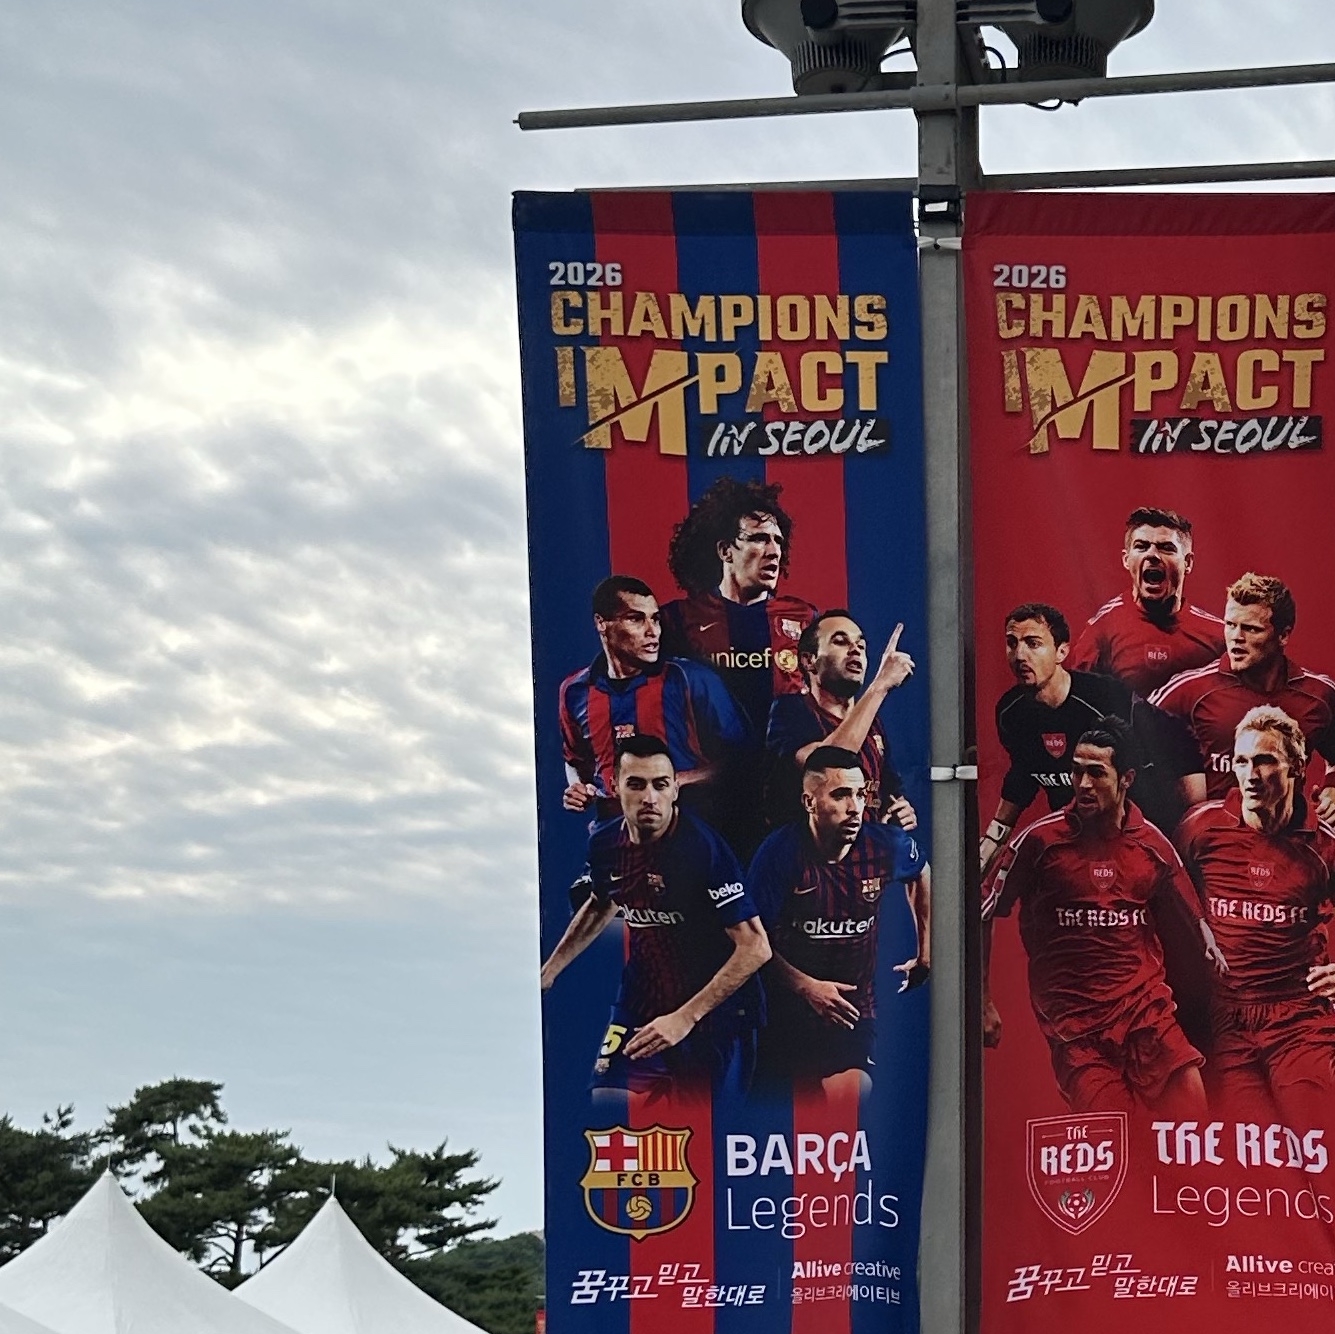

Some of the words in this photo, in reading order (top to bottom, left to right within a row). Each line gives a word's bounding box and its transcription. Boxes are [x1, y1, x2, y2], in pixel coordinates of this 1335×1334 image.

[548, 261, 623, 287] 2026
[993, 264, 1067, 289] 2026
[549, 290, 889, 343] CHAMPIONS
[995, 292, 1327, 342] CHAMPIONS
[554, 345, 890, 457] IMPACT
[1000, 346, 1325, 455] IMPACT
[758, 418, 886, 455] SEOUL
[1191, 416, 1317, 454] SEOUL
[707, 881, 744, 901] beko
[1055, 907, 1084, 927] THE
[1087, 908, 1130, 927] REDS
[1208, 897, 1238, 918] THE
[1241, 900, 1287, 923] REDS
[1289, 906, 1309, 924] FC
[600, 1024, 628, 1056] 5
[726, 1130, 872, 1183] BARÇA
[1041, 1140, 1115, 1176] REDS
[1151, 1121, 1225, 1167] THE
[1235, 1122, 1329, 1174] REDS
[617, 1173, 660, 1187] FCB
[727, 1179, 900, 1240] Legends
[1152, 1174, 1335, 1227] Legends
[657, 1262, 710, 1286] 믿고
[791, 1259, 842, 1280] Allive
[843, 1259, 901, 1281] creative
[1090, 1253, 1142, 1276] 믿고
[1225, 1254, 1294, 1274] Allive
[570, 1269, 659, 1305] 꿈꾸고
[681, 1284, 766, 1309] 말한대로
[1006, 1264, 1092, 1303] 꿈꾸고
[1113, 1274, 1199, 1299] 말한대로
